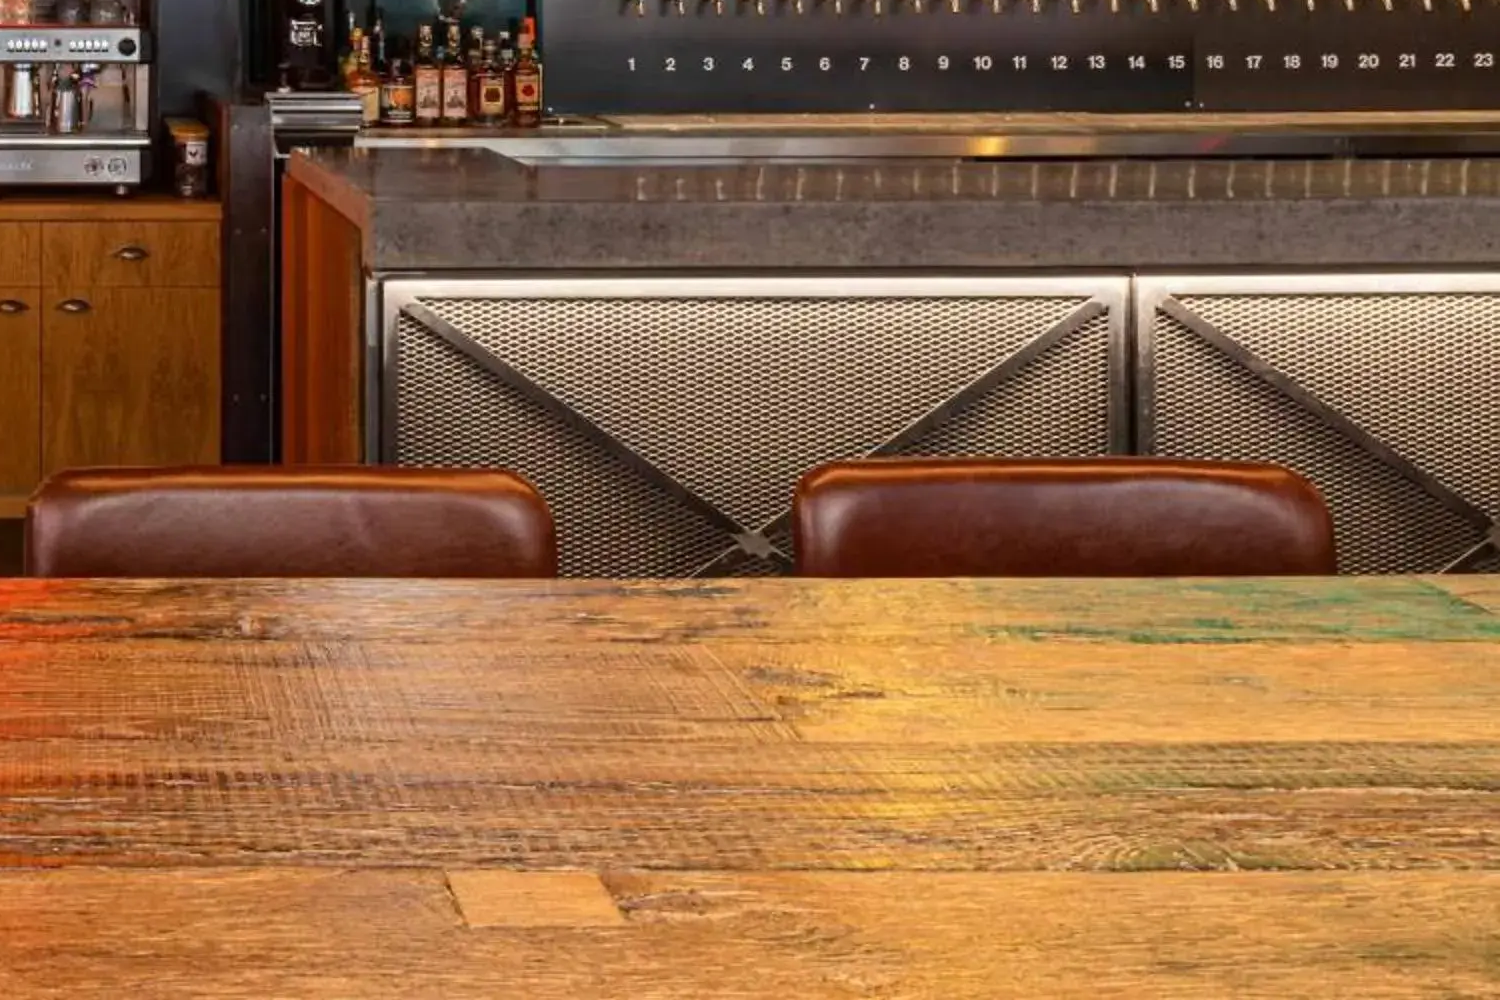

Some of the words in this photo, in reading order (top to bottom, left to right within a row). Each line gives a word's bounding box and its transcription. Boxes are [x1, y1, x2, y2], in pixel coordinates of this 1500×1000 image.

[627, 57, 635, 71] 1
[665, 57, 676, 72] 2
[703, 56, 715, 71] 3
[742, 57, 754, 71] 4
[781, 56, 793, 71] 5
[819, 56, 831, 71] 6
[859, 56, 870, 71] 7
[898, 55, 910, 71] 8
[937, 55, 950, 70] 9
[973, 55, 993, 70] 10
[1012, 55, 1027, 70] 11
[1050, 55, 1068, 70] 12
[1087, 54, 1106, 69] 13
[1128, 55, 1145, 69] 14
[1167, 55, 1185, 69] 15
[1206, 55, 1224, 69] 16
[1245, 55, 1263, 69] 17
[1283, 54, 1301, 69] 18
[1321, 53, 1339, 69] 19
[1358, 53, 1380, 69] 20
[1398, 53, 1416, 68] 21
[1435, 53, 1455, 68] 22
[1473, 52, 1494, 67] 23
